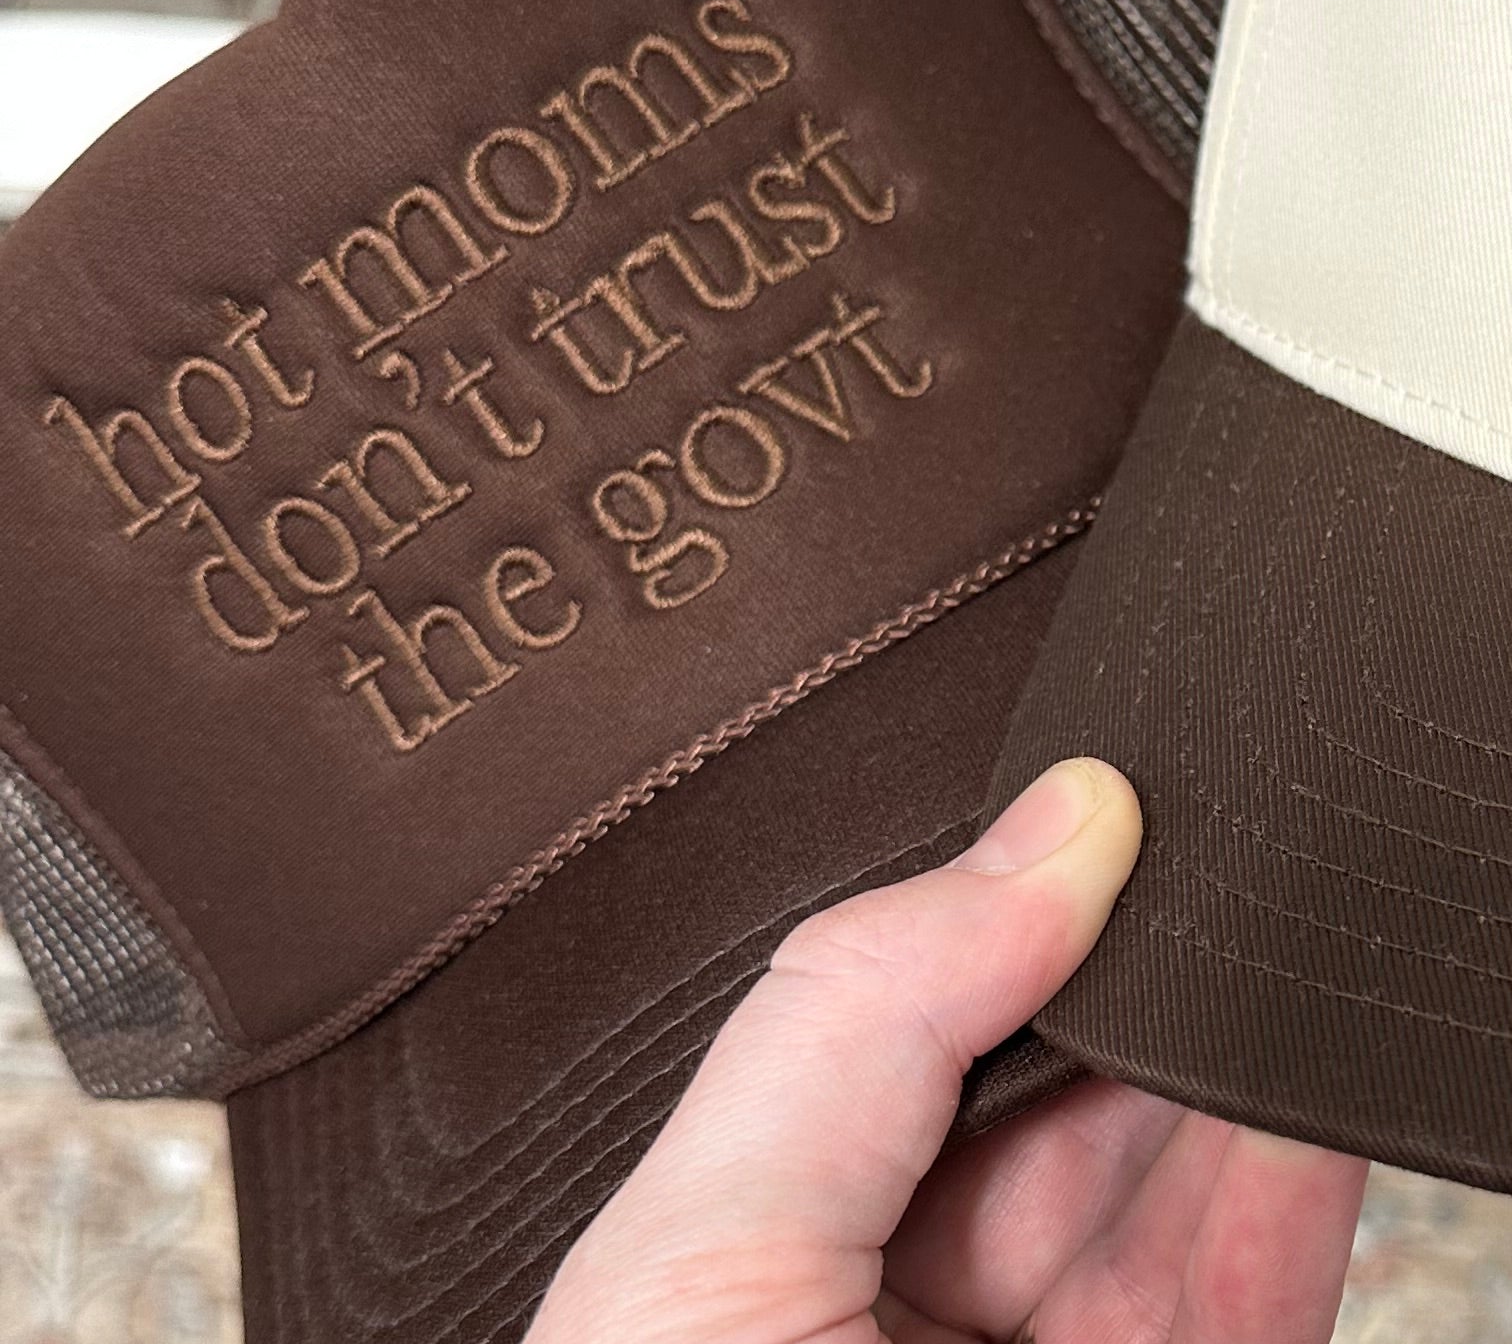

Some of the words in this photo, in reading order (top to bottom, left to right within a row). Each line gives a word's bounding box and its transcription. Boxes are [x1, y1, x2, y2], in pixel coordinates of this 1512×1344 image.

[43, 298, 314, 538] hot
[182, 349, 543, 653] don't
[530, 114, 896, 396] trust
[340, 546, 583, 751] the
[591, 293, 934, 612] govt
